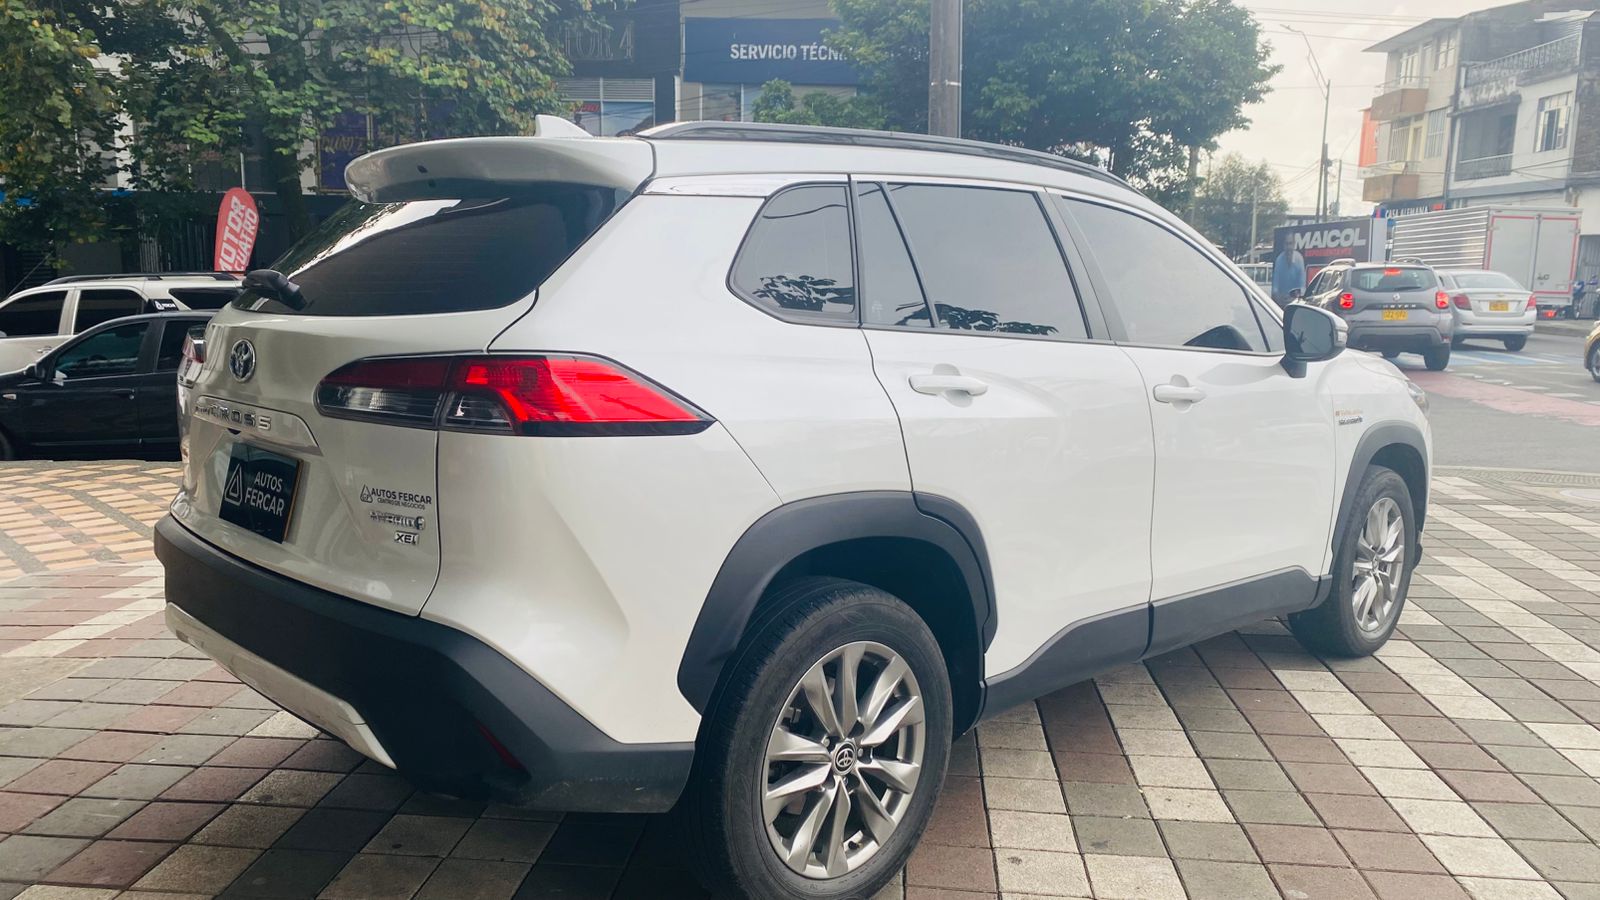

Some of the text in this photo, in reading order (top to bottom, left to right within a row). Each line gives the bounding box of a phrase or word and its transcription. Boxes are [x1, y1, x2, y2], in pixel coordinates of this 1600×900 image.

[730, 43, 797, 60] SERVICIO
[1294, 227, 1366, 250] MAICOL
[254, 471, 283, 493] AUTOS
[244, 487, 285, 517] FERCAR
[371, 487, 397, 500] AUTOS
[398, 491, 432, 505] FERCAR
